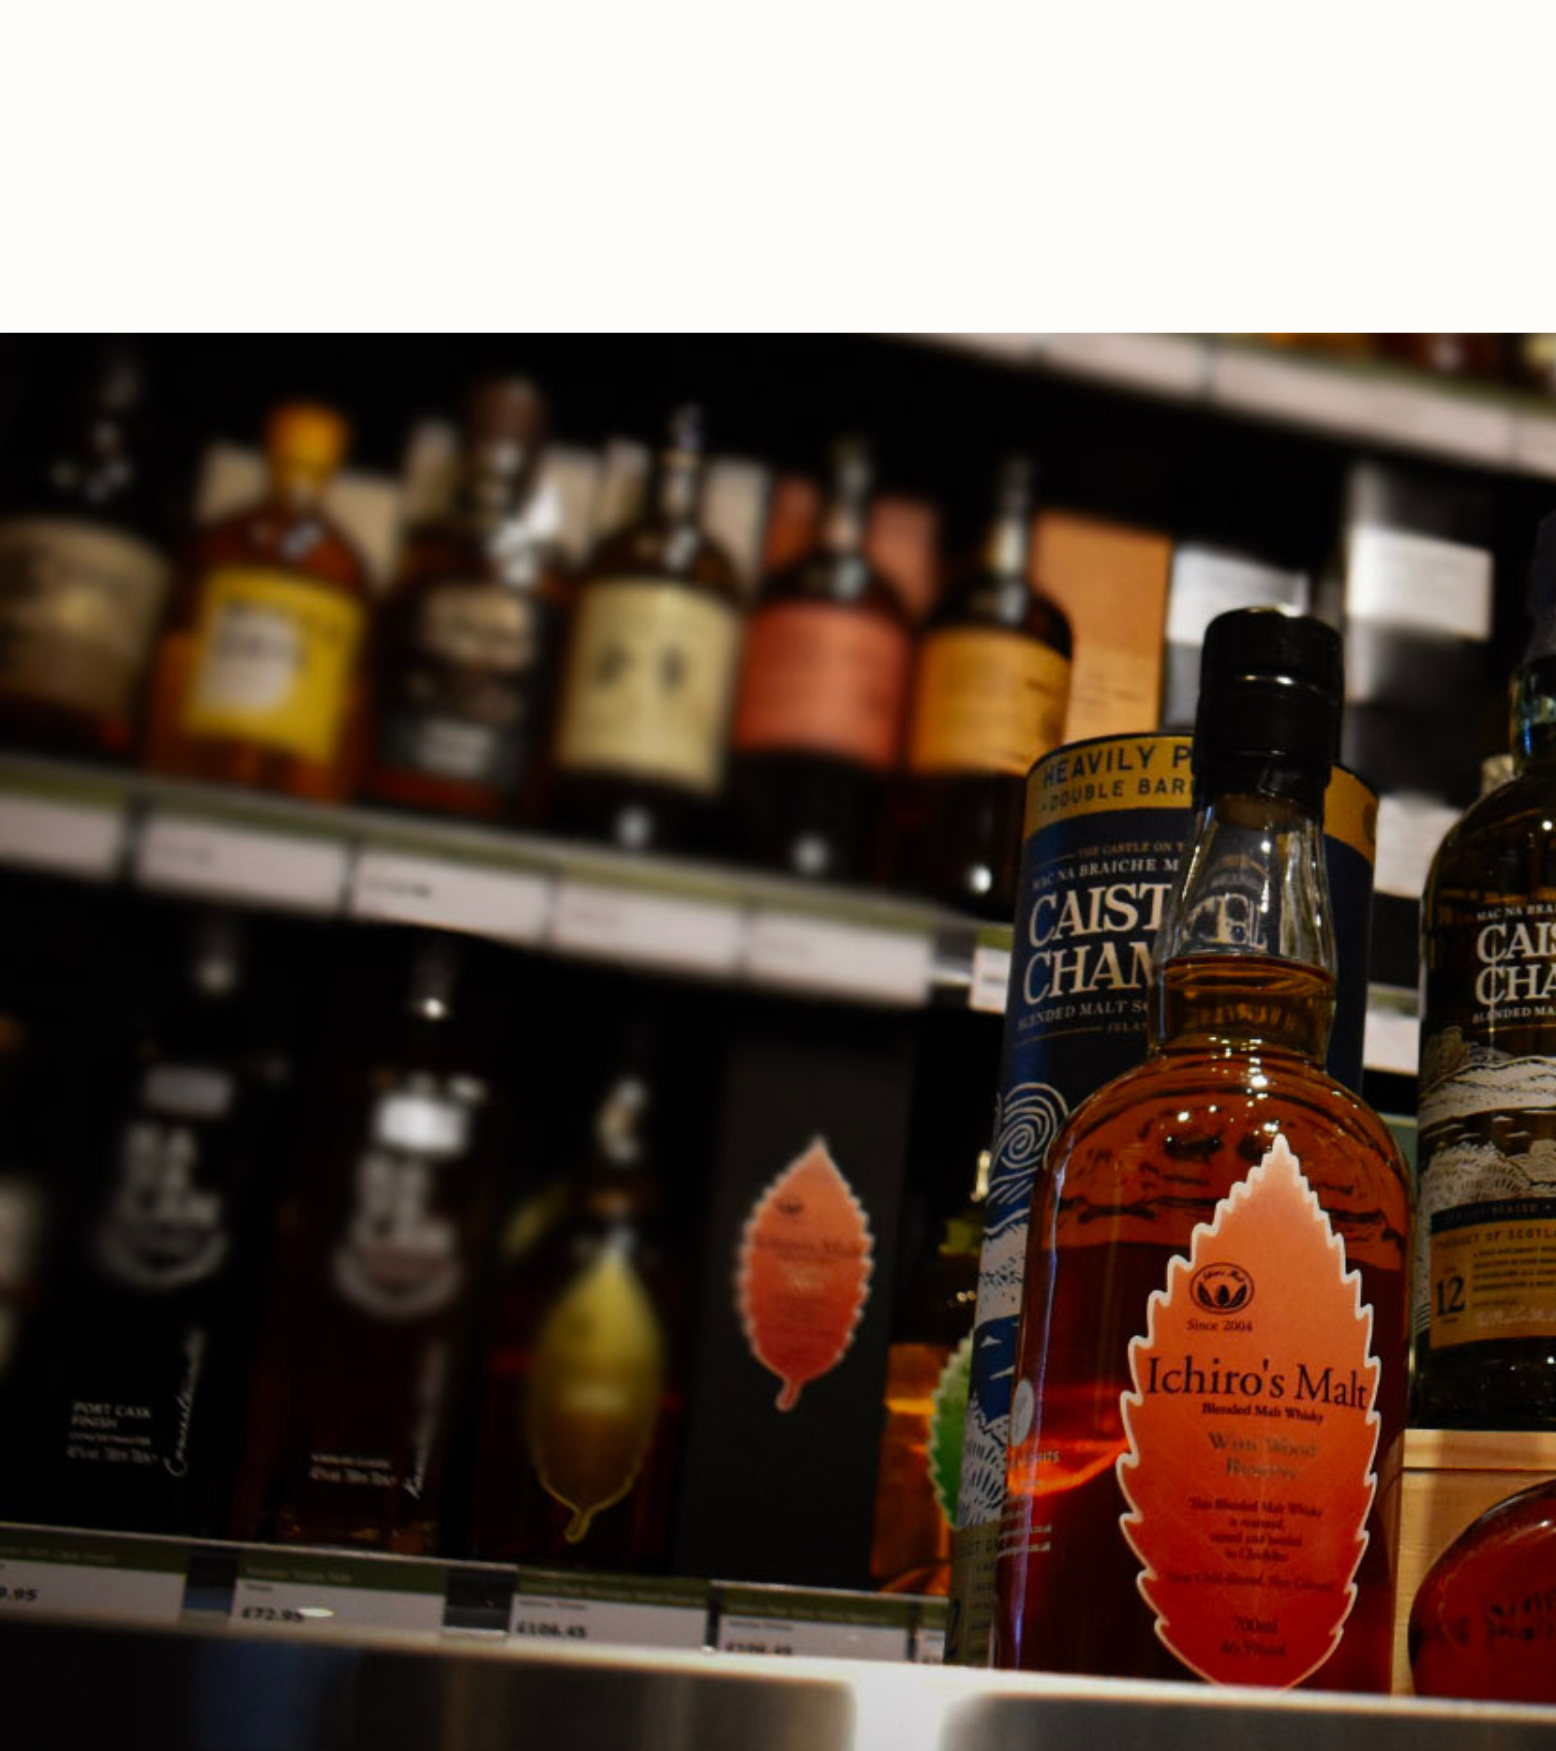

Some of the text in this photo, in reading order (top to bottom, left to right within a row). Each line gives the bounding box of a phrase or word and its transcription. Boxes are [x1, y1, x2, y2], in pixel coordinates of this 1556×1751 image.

[1042, 744, 1156, 790] HEAVILY
[1050, 779, 1125, 813] DOUBLE
[1028, 882, 1172, 948] CAIST
[1504, 905, 1524, 917] NA
[1022, 941, 1155, 1007] CHAM
[1079, 1000, 1128, 1017] MALT
[1472, 1005, 1532, 1024] BLENDED
[1485, 1229, 1502, 1242] OF
[1436, 1275, 1466, 1317] 12
[1186, 1318, 1219, 1332] Since
[1147, 1353, 1368, 1412] Ichiro's Malt
[114, 1404, 152, 1419] CASK
[1201, 1402, 1324, 1425] Blended Malt Whisky
